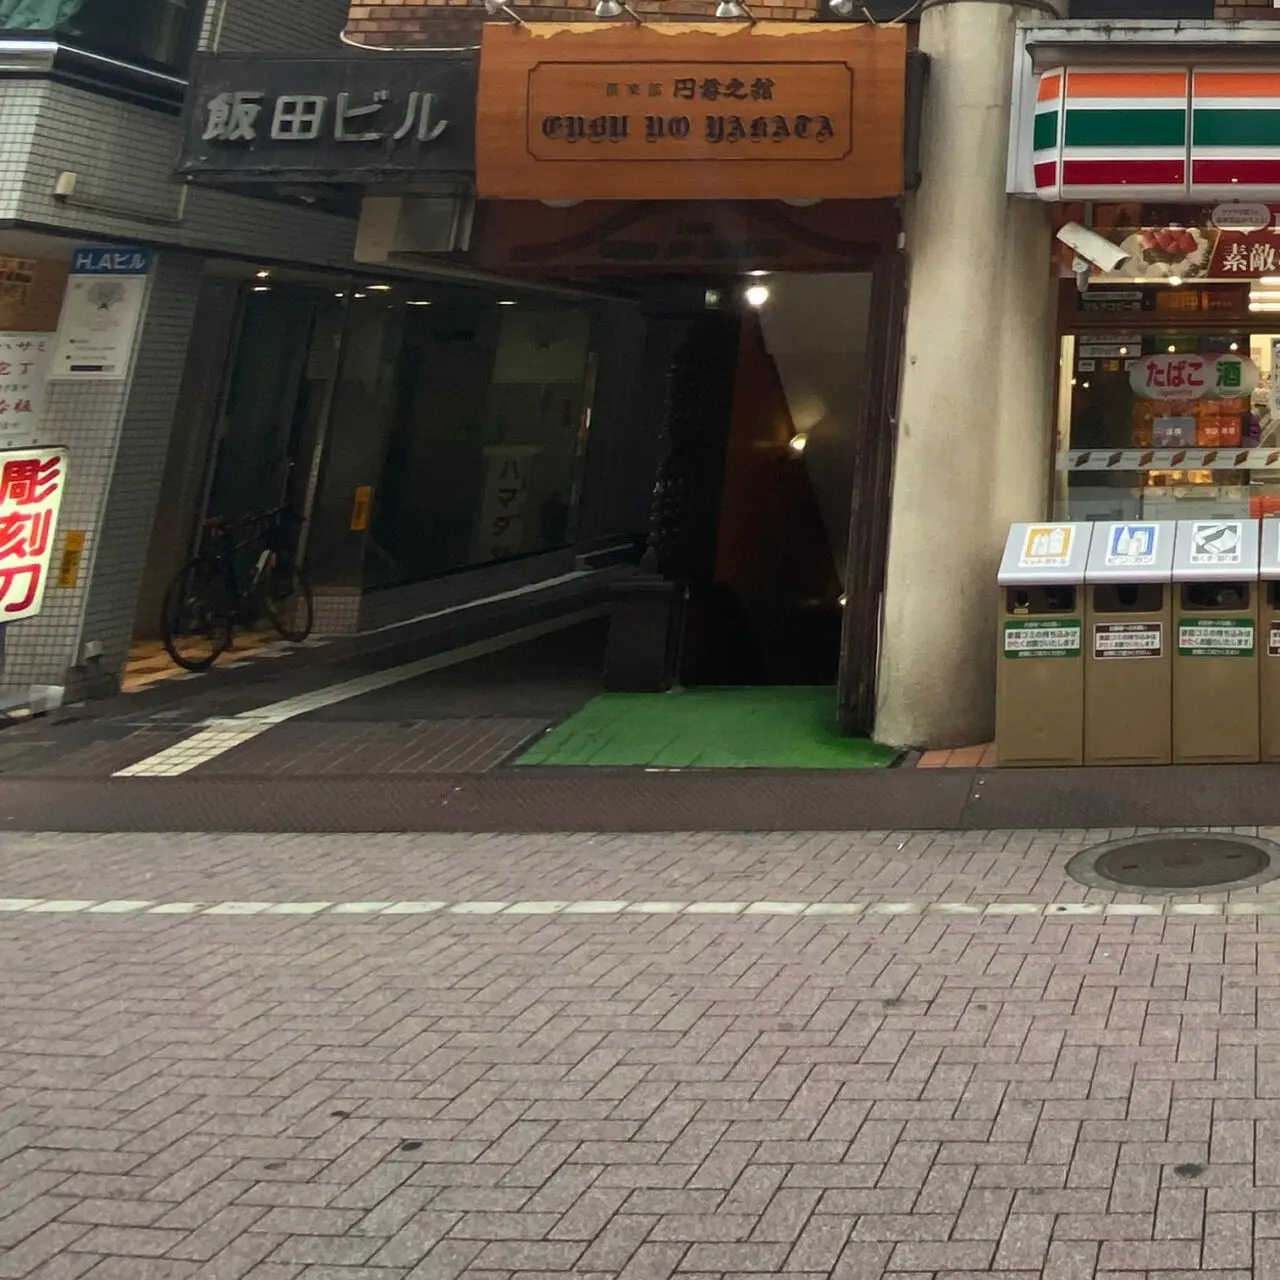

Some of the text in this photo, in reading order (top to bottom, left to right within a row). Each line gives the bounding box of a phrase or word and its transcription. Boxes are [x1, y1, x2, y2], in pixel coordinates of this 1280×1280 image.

[201, 89, 451, 144] 飯田ビル
[1146, 360, 1204, 387] たばこ
[1215, 360, 1241, 387] 酒
[0, 456, 61, 612] 彫刻刀
